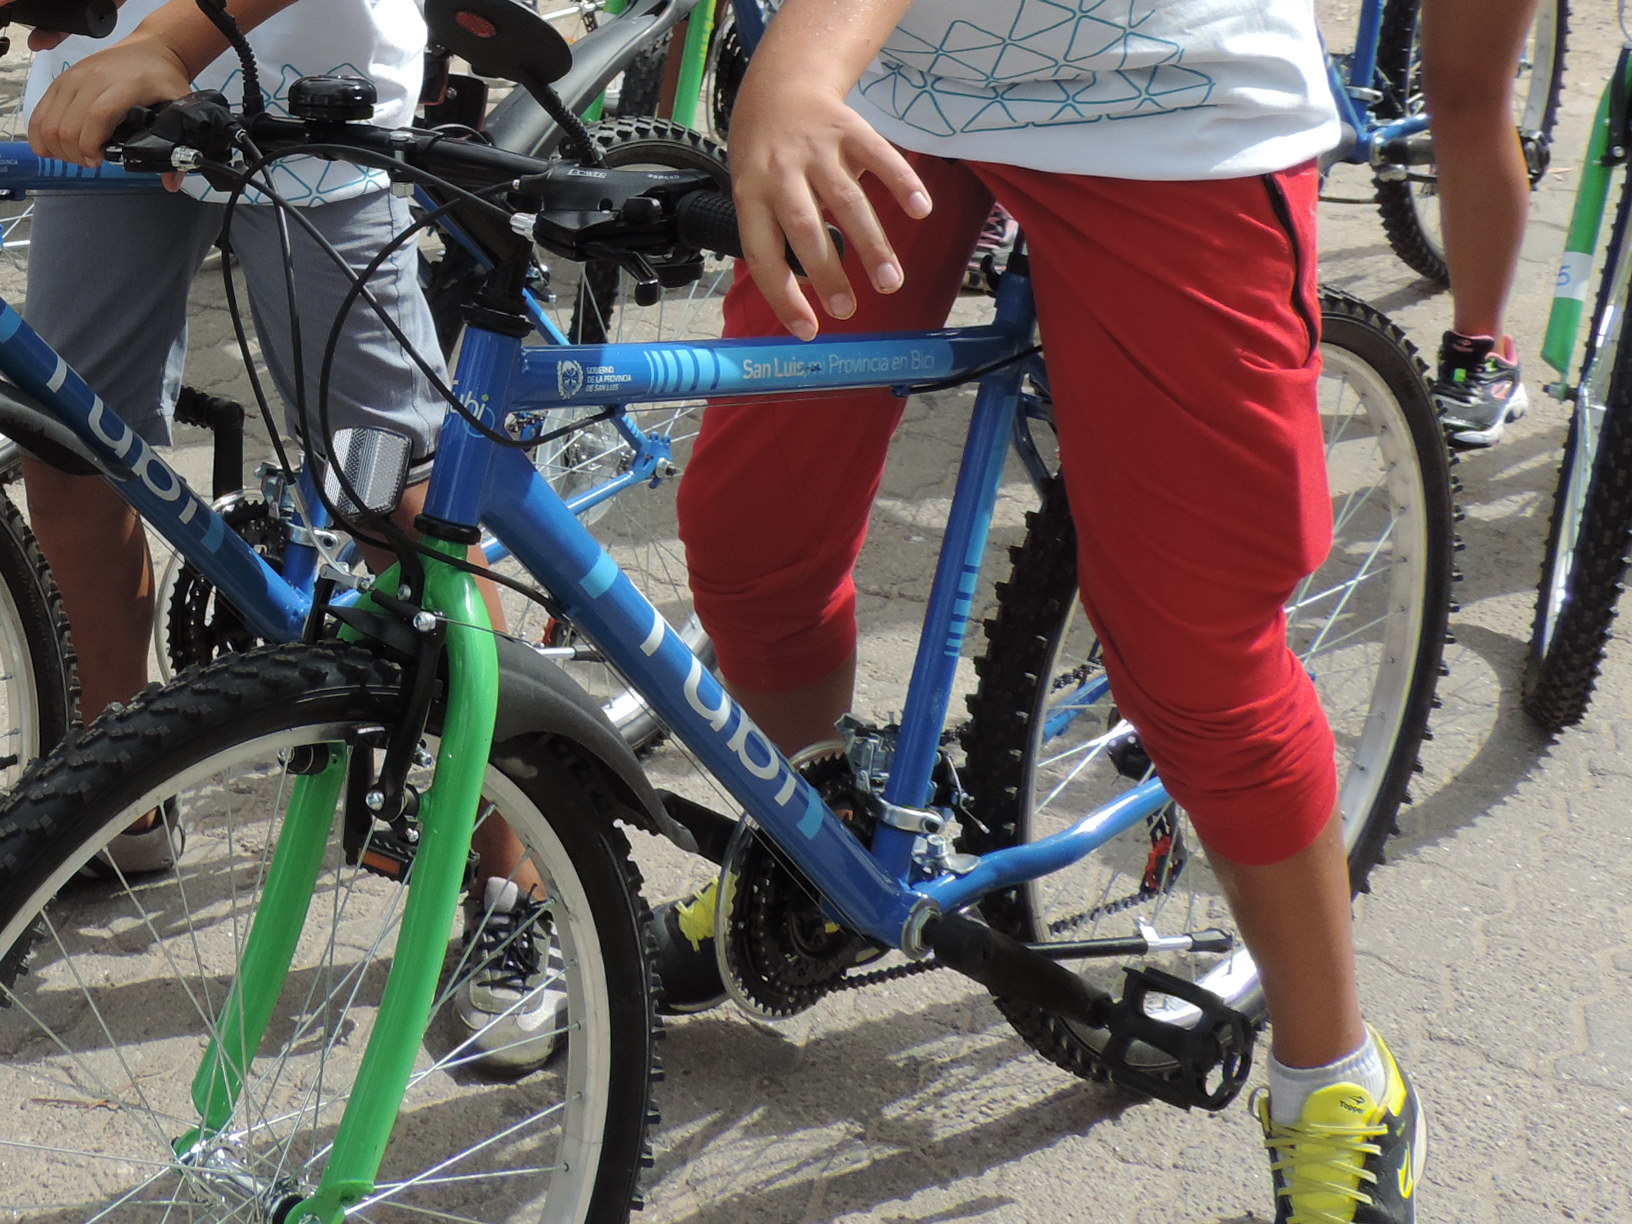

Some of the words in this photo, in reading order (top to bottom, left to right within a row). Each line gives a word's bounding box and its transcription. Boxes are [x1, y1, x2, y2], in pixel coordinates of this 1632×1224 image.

[586, 365, 615, 375] GOBIERNO
[742, 359, 771, 379] San
[774, 357, 807, 378] Luis,
[829, 353, 889, 375] Provincia
[891, 358, 909, 372] en
[910, 349, 935, 370] Bici
[586, 375, 595, 384] DE
[595, 375, 604, 383] LA
[603, 374, 632, 383] PROVINCIA
[585, 384, 594, 392] DE
[594, 383, 607, 392] SAN
[606, 383, 619, 392] LUIS
[38, 334, 199, 526] Tubi
[629, 579, 798, 808] Tubi
[1339, 1100, 1365, 1114] Topper
